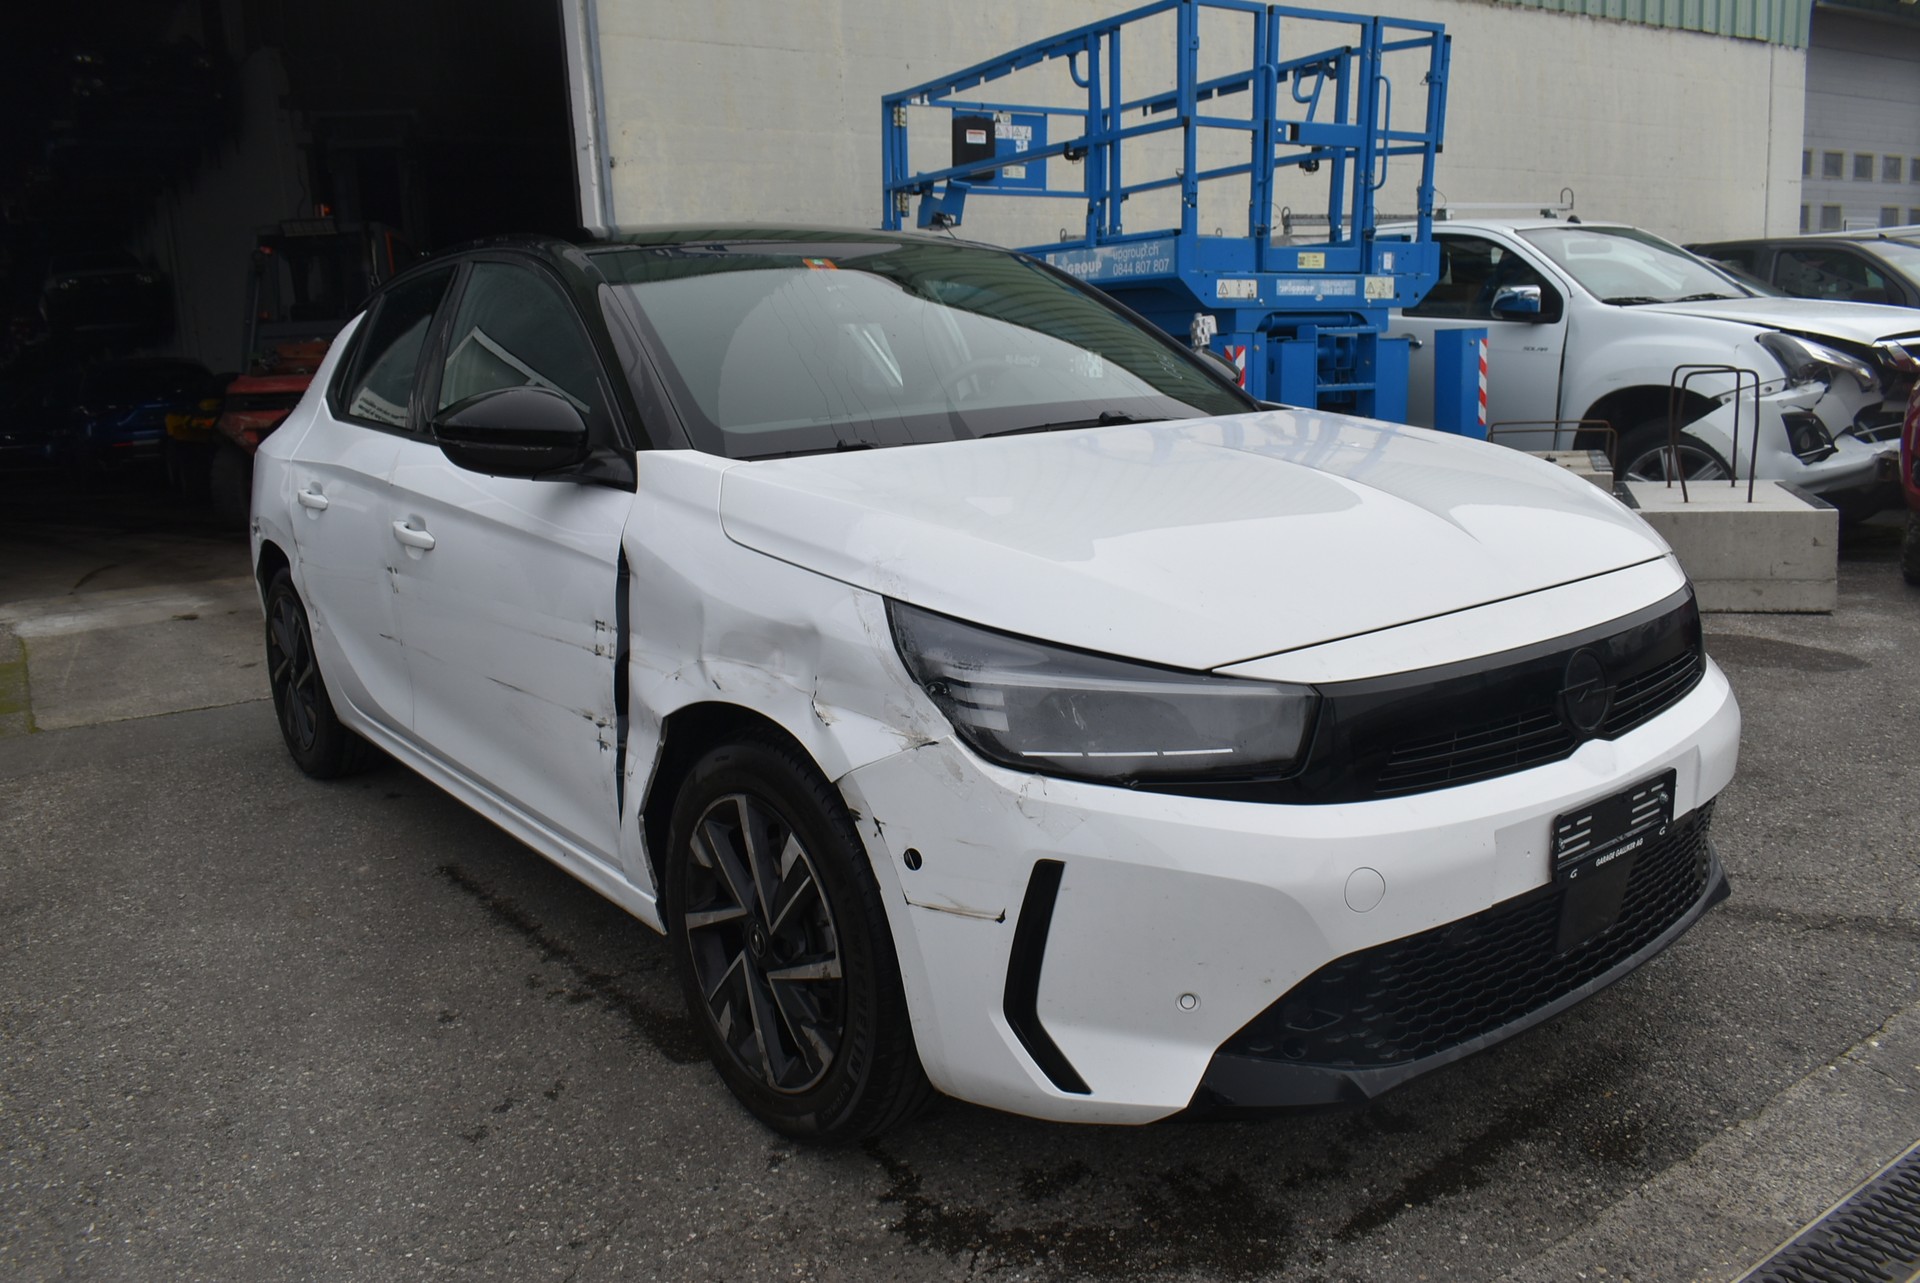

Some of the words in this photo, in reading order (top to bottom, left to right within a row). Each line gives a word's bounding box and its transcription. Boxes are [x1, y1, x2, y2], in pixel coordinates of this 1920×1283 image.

[1112, 242, 1159, 262] upgroup.ch
[1112, 263, 1134, 276] 0844
[1135, 260, 1151, 274] 807
[1153, 258, 1170, 272] 807
[1595, 851, 1616, 867] GARAGE
[1636, 837, 1644, 847] AG
